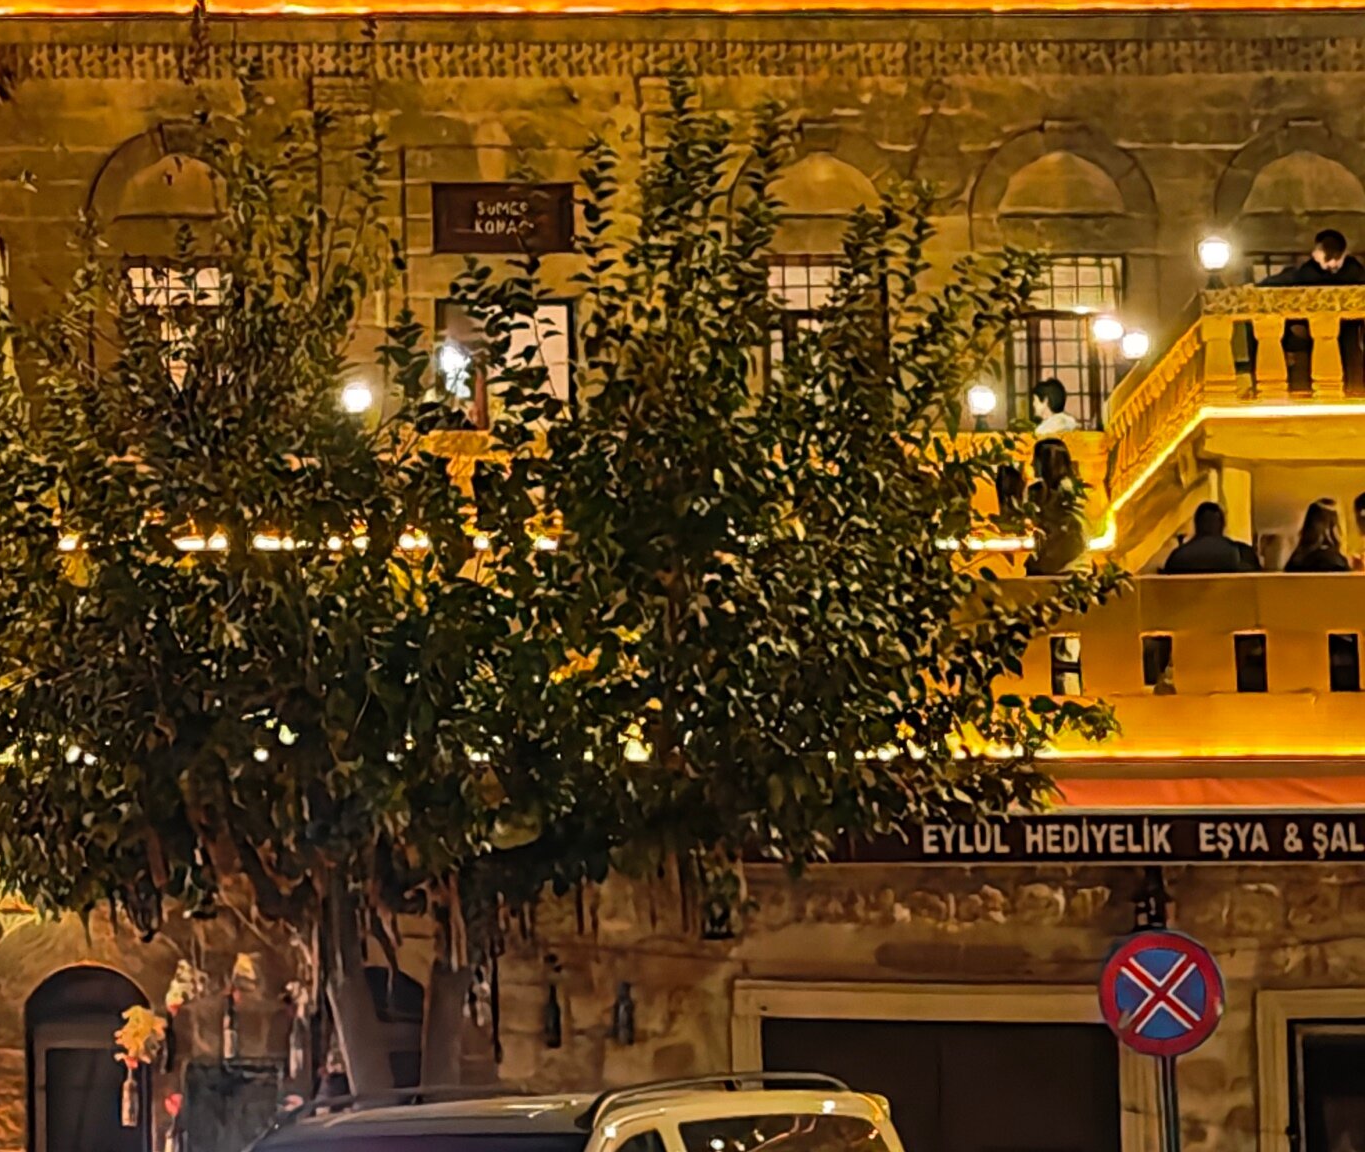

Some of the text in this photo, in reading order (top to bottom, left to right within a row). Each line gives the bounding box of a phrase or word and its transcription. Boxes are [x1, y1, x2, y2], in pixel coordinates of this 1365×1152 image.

[1025, 816, 1172, 854] HEDİYELİK
[1198, 821, 1270, 859] EŞYA
[1283, 821, 1304, 853] &
